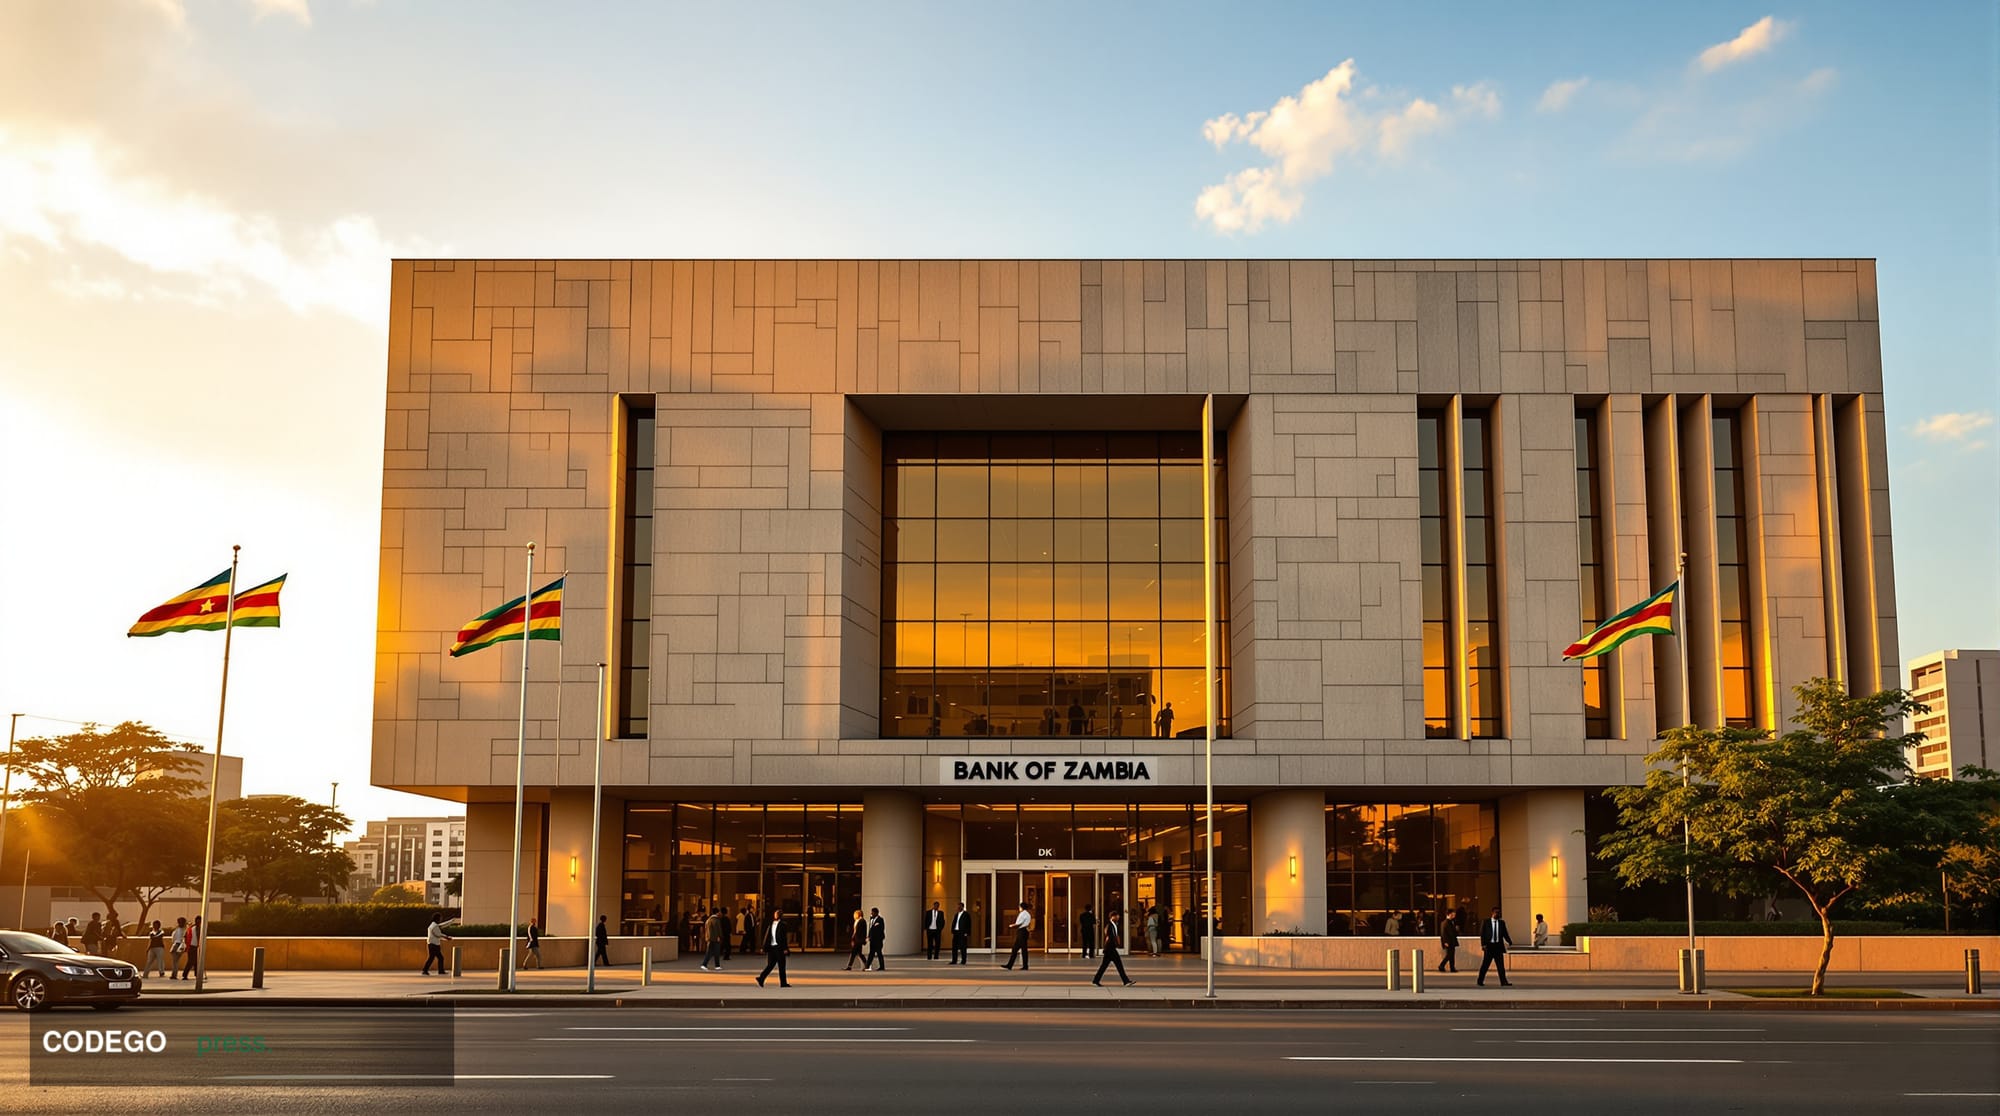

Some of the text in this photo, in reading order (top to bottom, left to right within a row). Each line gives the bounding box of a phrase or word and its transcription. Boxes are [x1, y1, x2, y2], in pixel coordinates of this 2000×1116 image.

[954, 761, 1150, 780] BANK OF ZAMBIA
